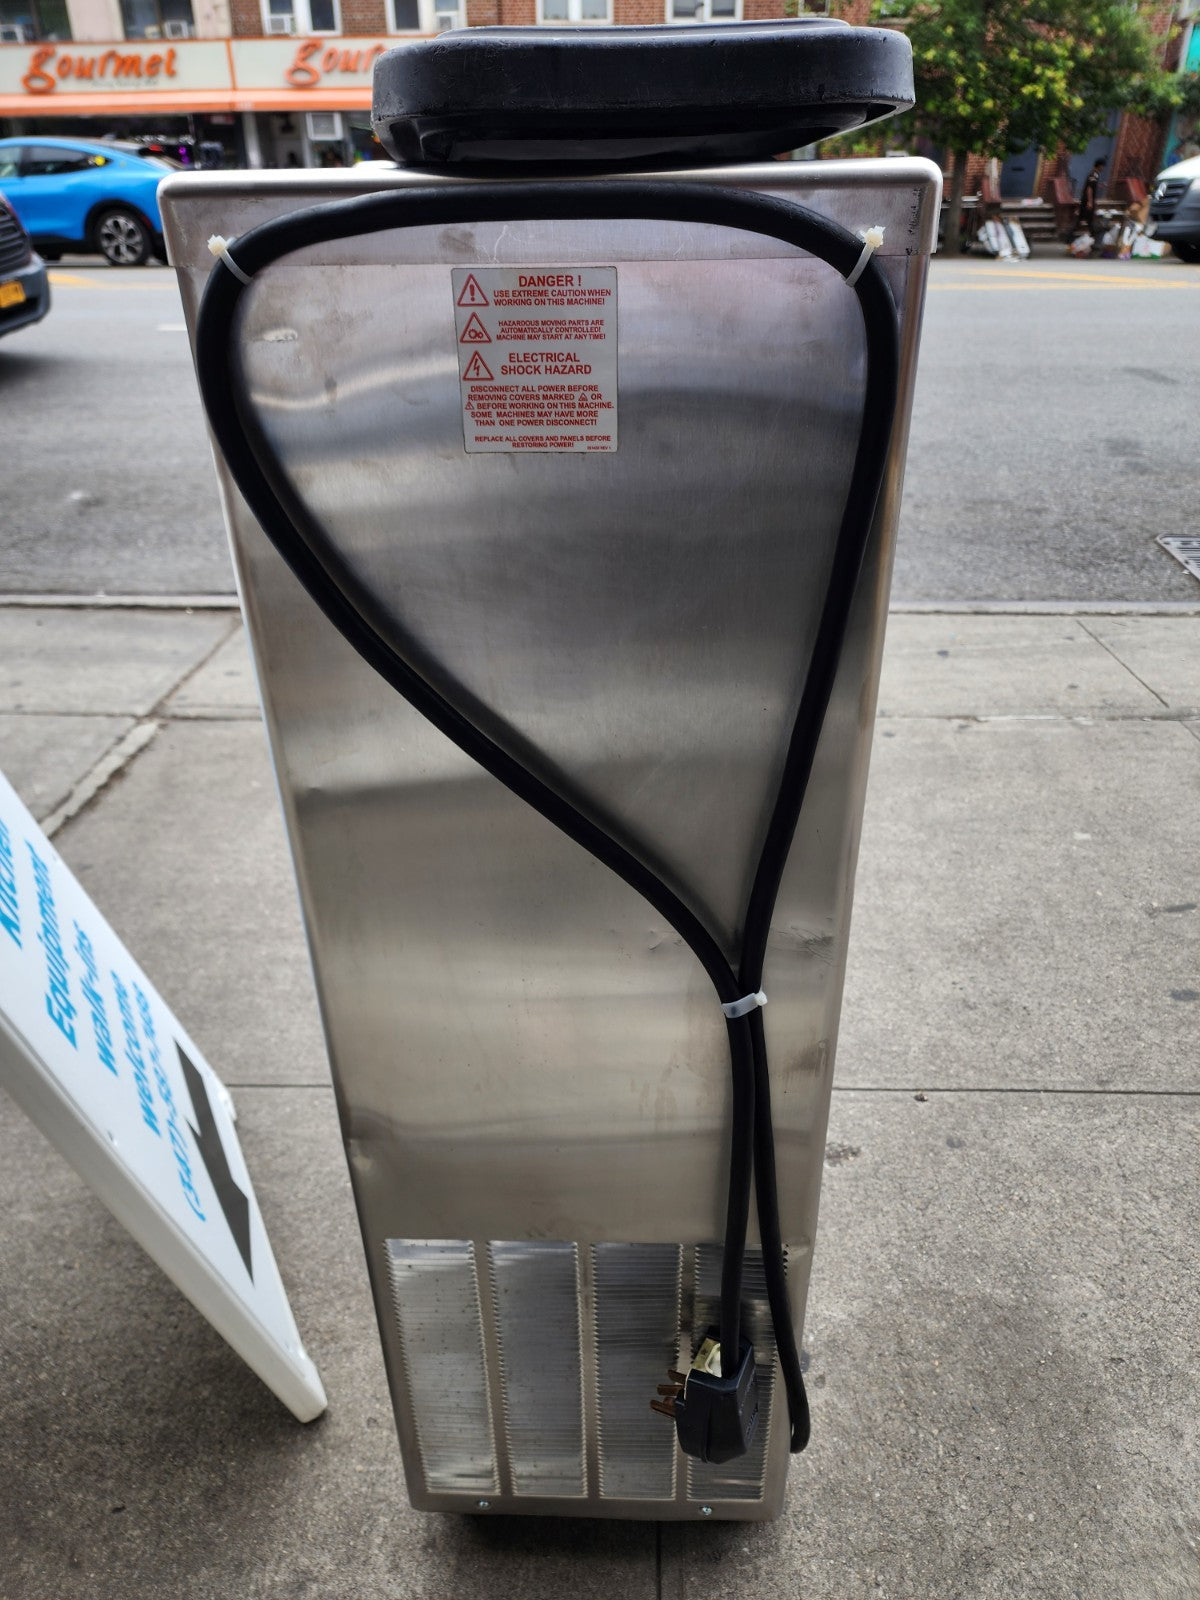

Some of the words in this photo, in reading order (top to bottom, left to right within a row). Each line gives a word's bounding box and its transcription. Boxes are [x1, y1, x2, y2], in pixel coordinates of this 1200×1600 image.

[21, 46, 177, 94] gourmet
[285, 38, 386, 88] gour
[494, 290, 510, 298] USE
[512, 290, 550, 298] EXTREME
[551, 289, 587, 297] CAUTION
[588, 289, 612, 297] WHEN
[519, 275, 574, 287] DANGER
[501, 365, 541, 375] SHOCK
[544, 365, 592, 375] HAZARD
[509, 353, 580, 363] ELECTRICAL
[24, 838, 79, 1050] Equipment
[110, 970, 161, 1137] welcome
